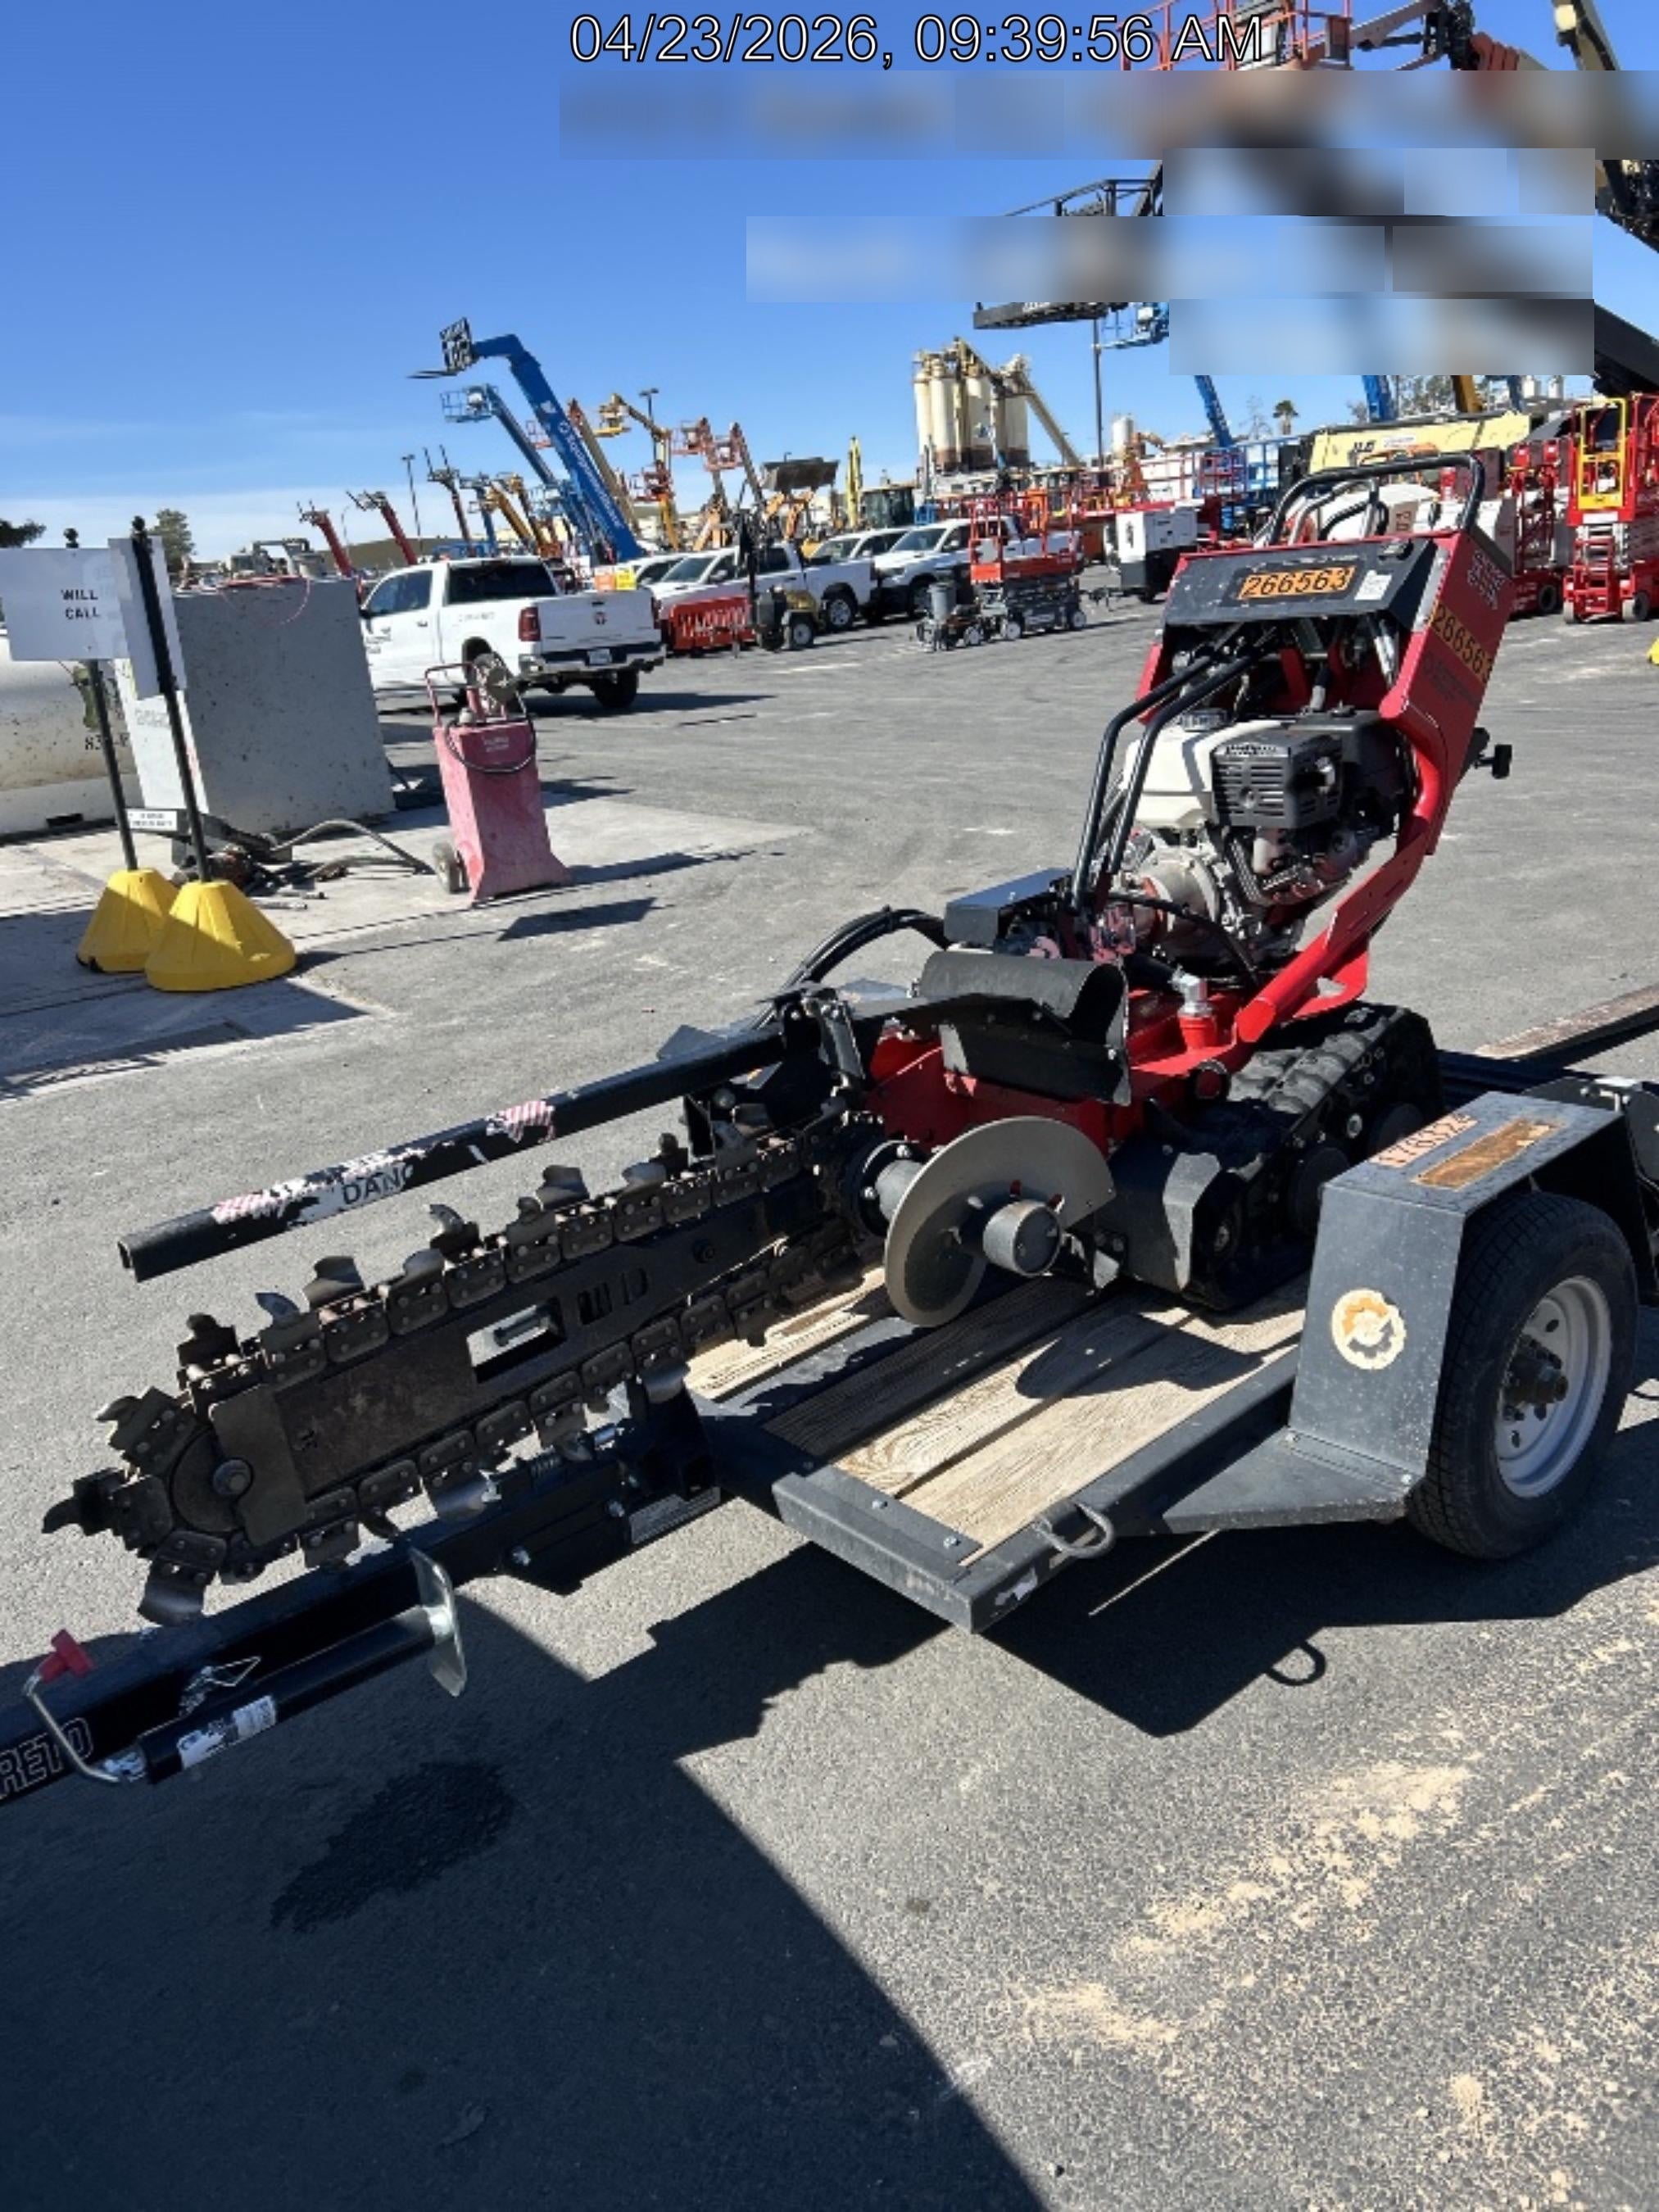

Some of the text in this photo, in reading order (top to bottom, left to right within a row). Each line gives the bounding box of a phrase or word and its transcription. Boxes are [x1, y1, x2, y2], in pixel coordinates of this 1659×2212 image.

[1243, 566, 1351, 596] 266563
[61, 589, 99, 601] WILL
[65, 607, 101, 620] CALL
